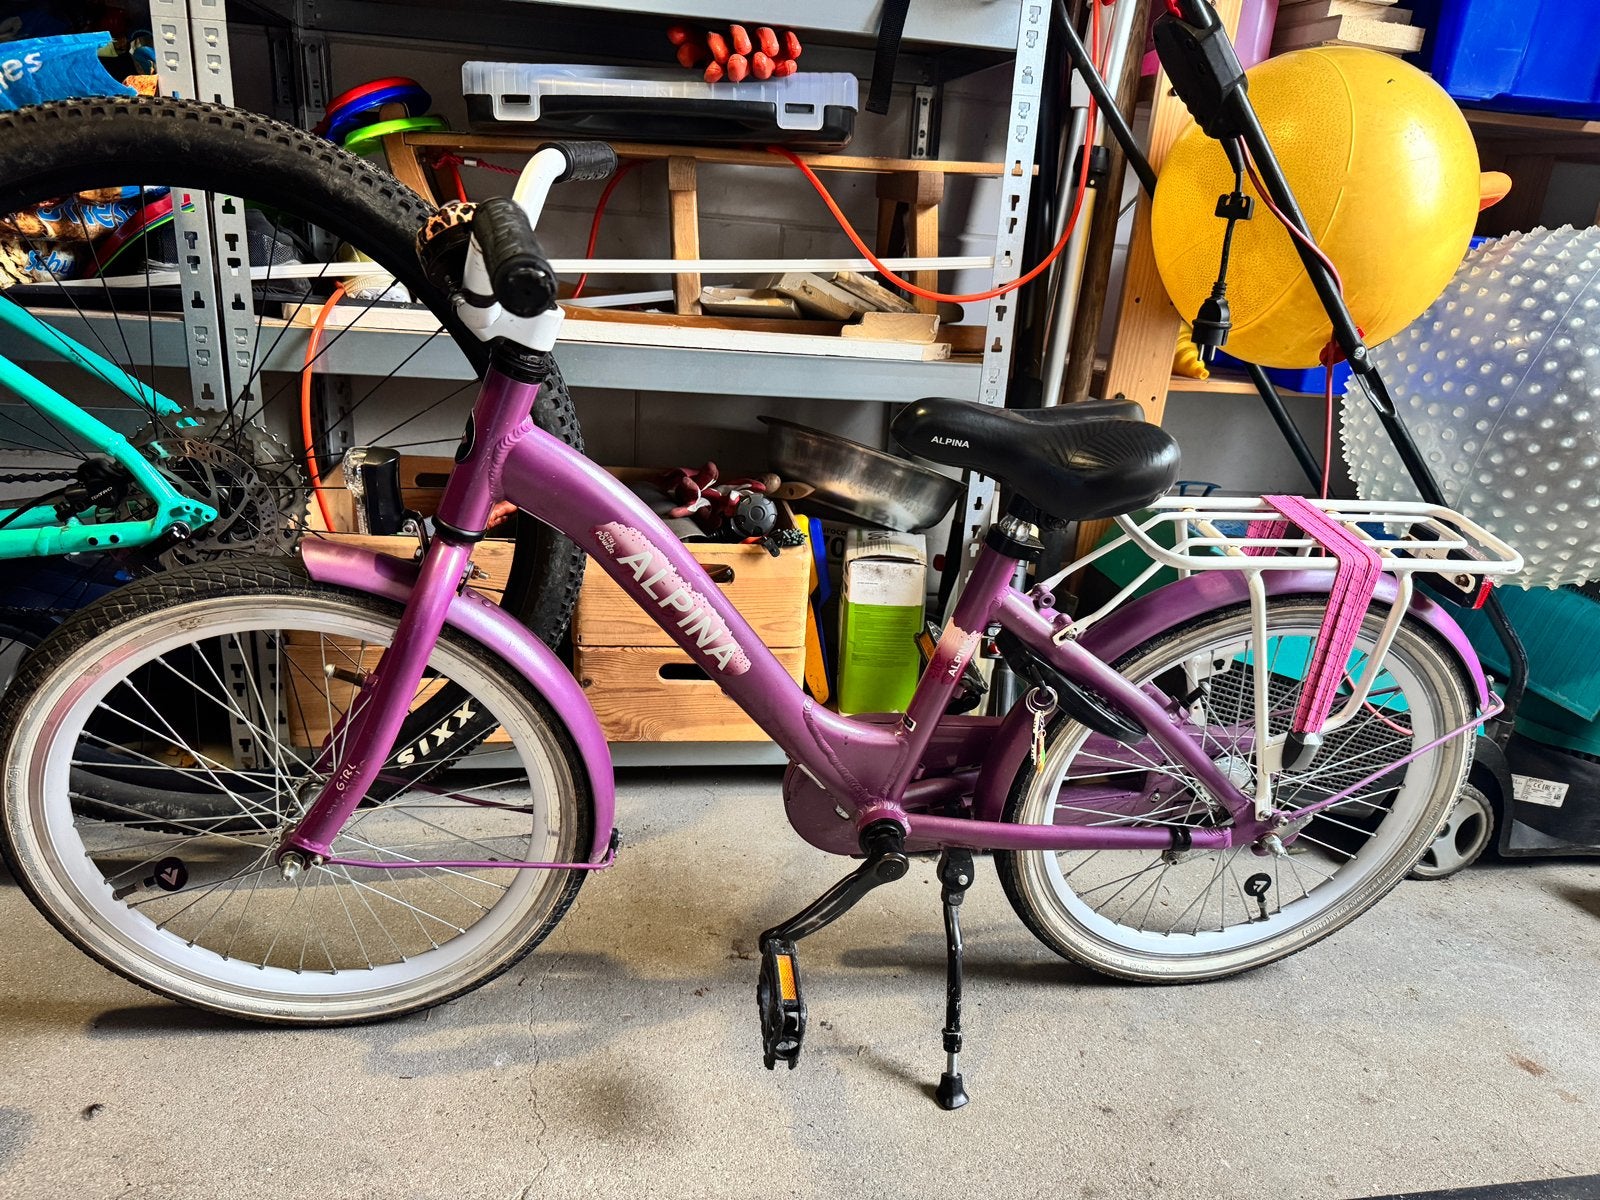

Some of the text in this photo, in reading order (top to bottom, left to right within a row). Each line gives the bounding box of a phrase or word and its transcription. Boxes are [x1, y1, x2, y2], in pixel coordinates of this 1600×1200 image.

[930, 435, 970, 449] ALPINA
[595, 530, 615, 554] POWER
[616, 550, 737, 671] ALPINA
[397, 700, 477, 769] SIXX
